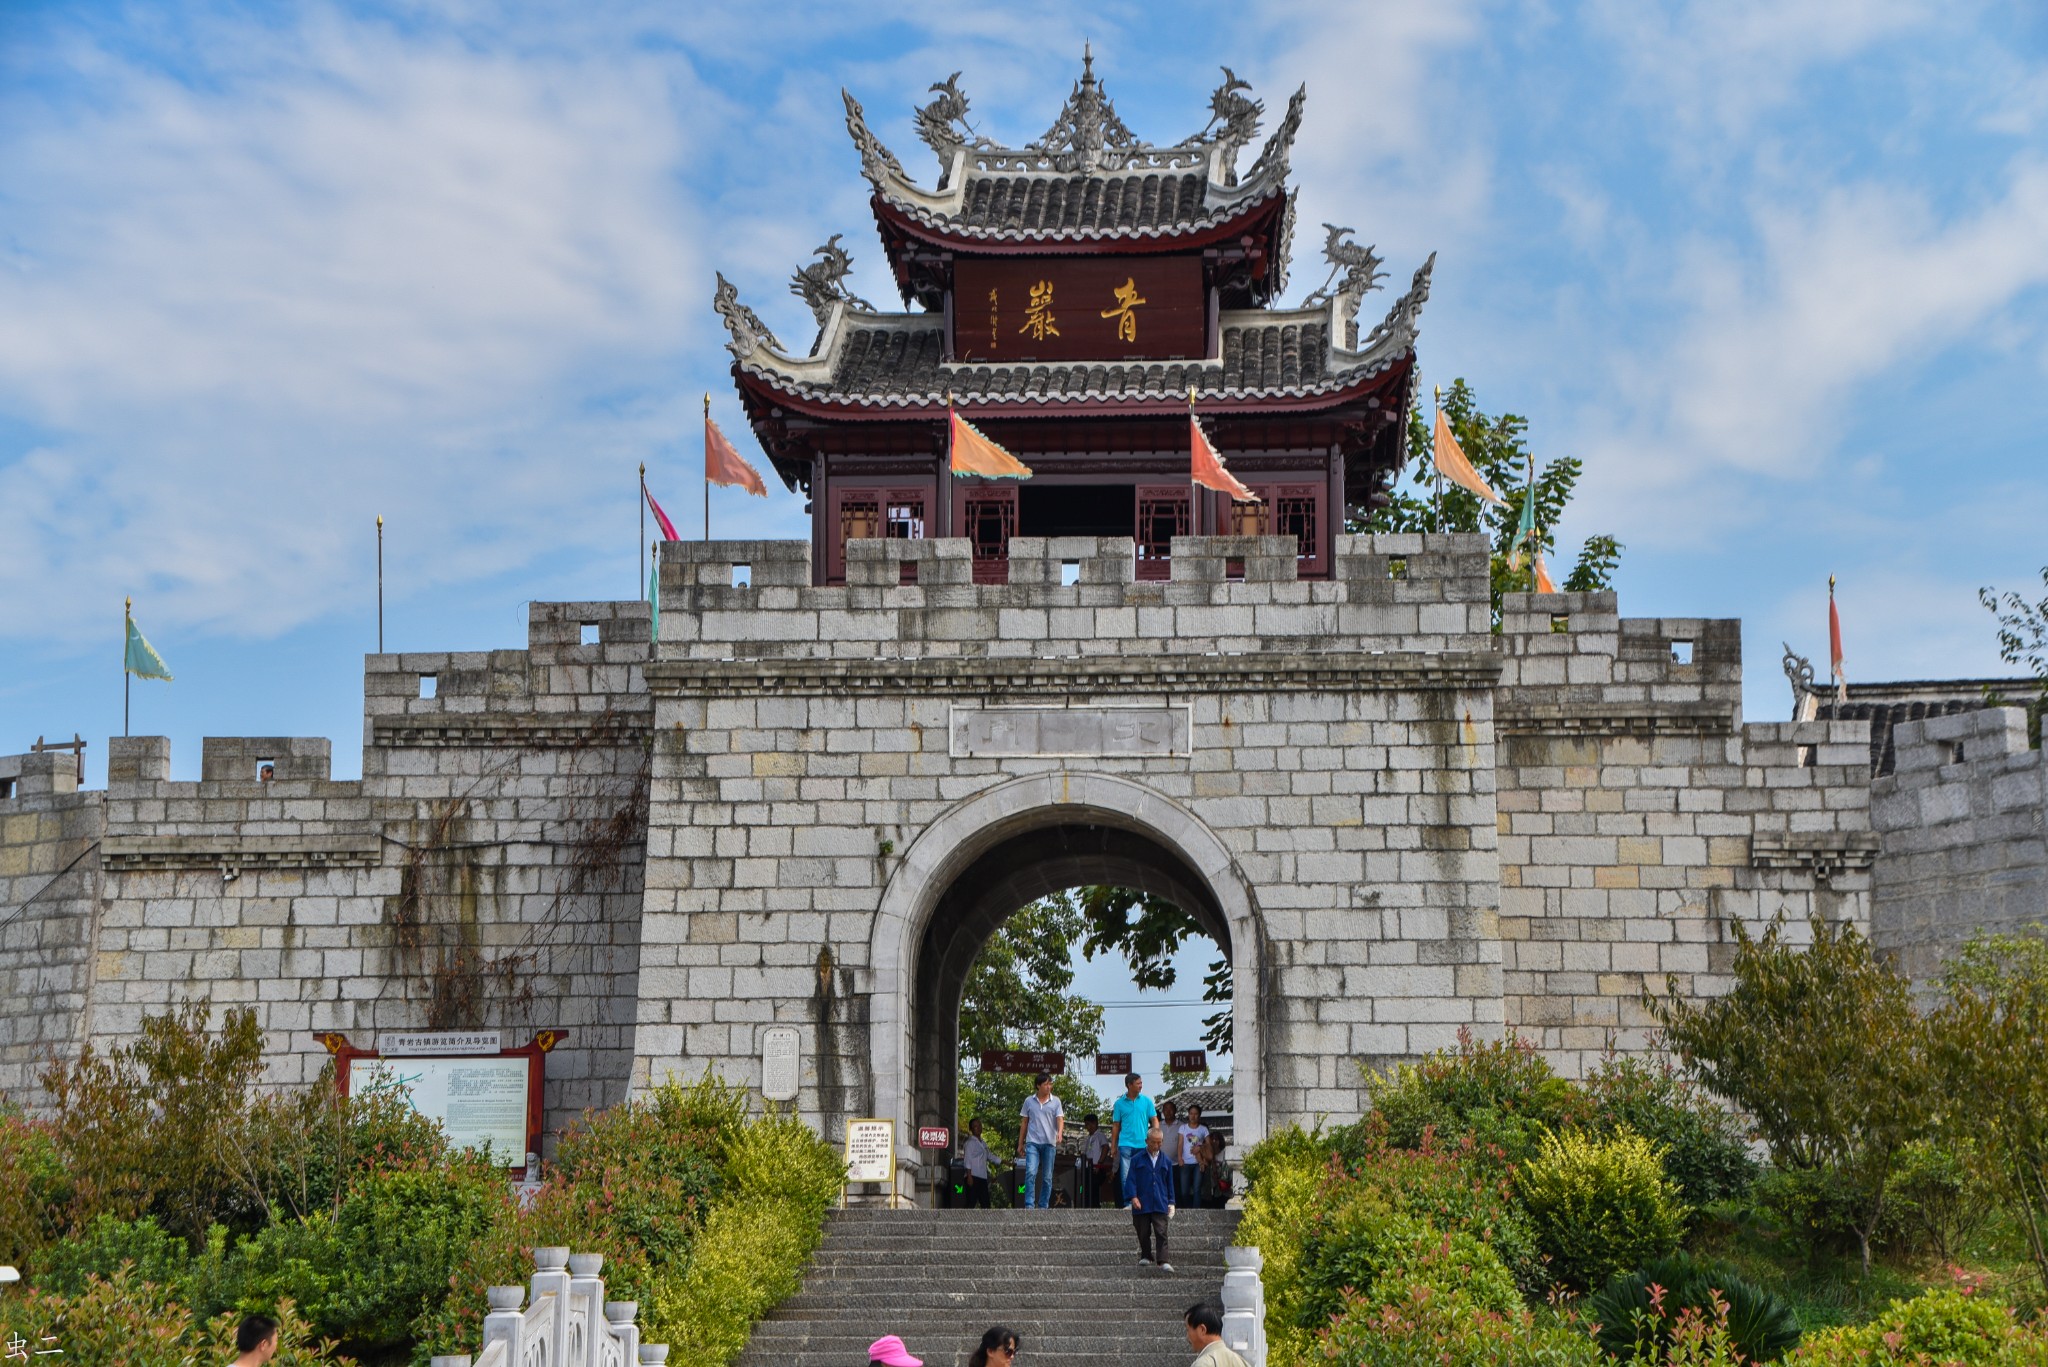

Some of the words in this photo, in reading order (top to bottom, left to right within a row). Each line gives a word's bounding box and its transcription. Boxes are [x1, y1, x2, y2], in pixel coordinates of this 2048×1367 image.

[1175, 1056, 1201, 1067] 出口
[921, 1130, 946, 1142] 检票处
